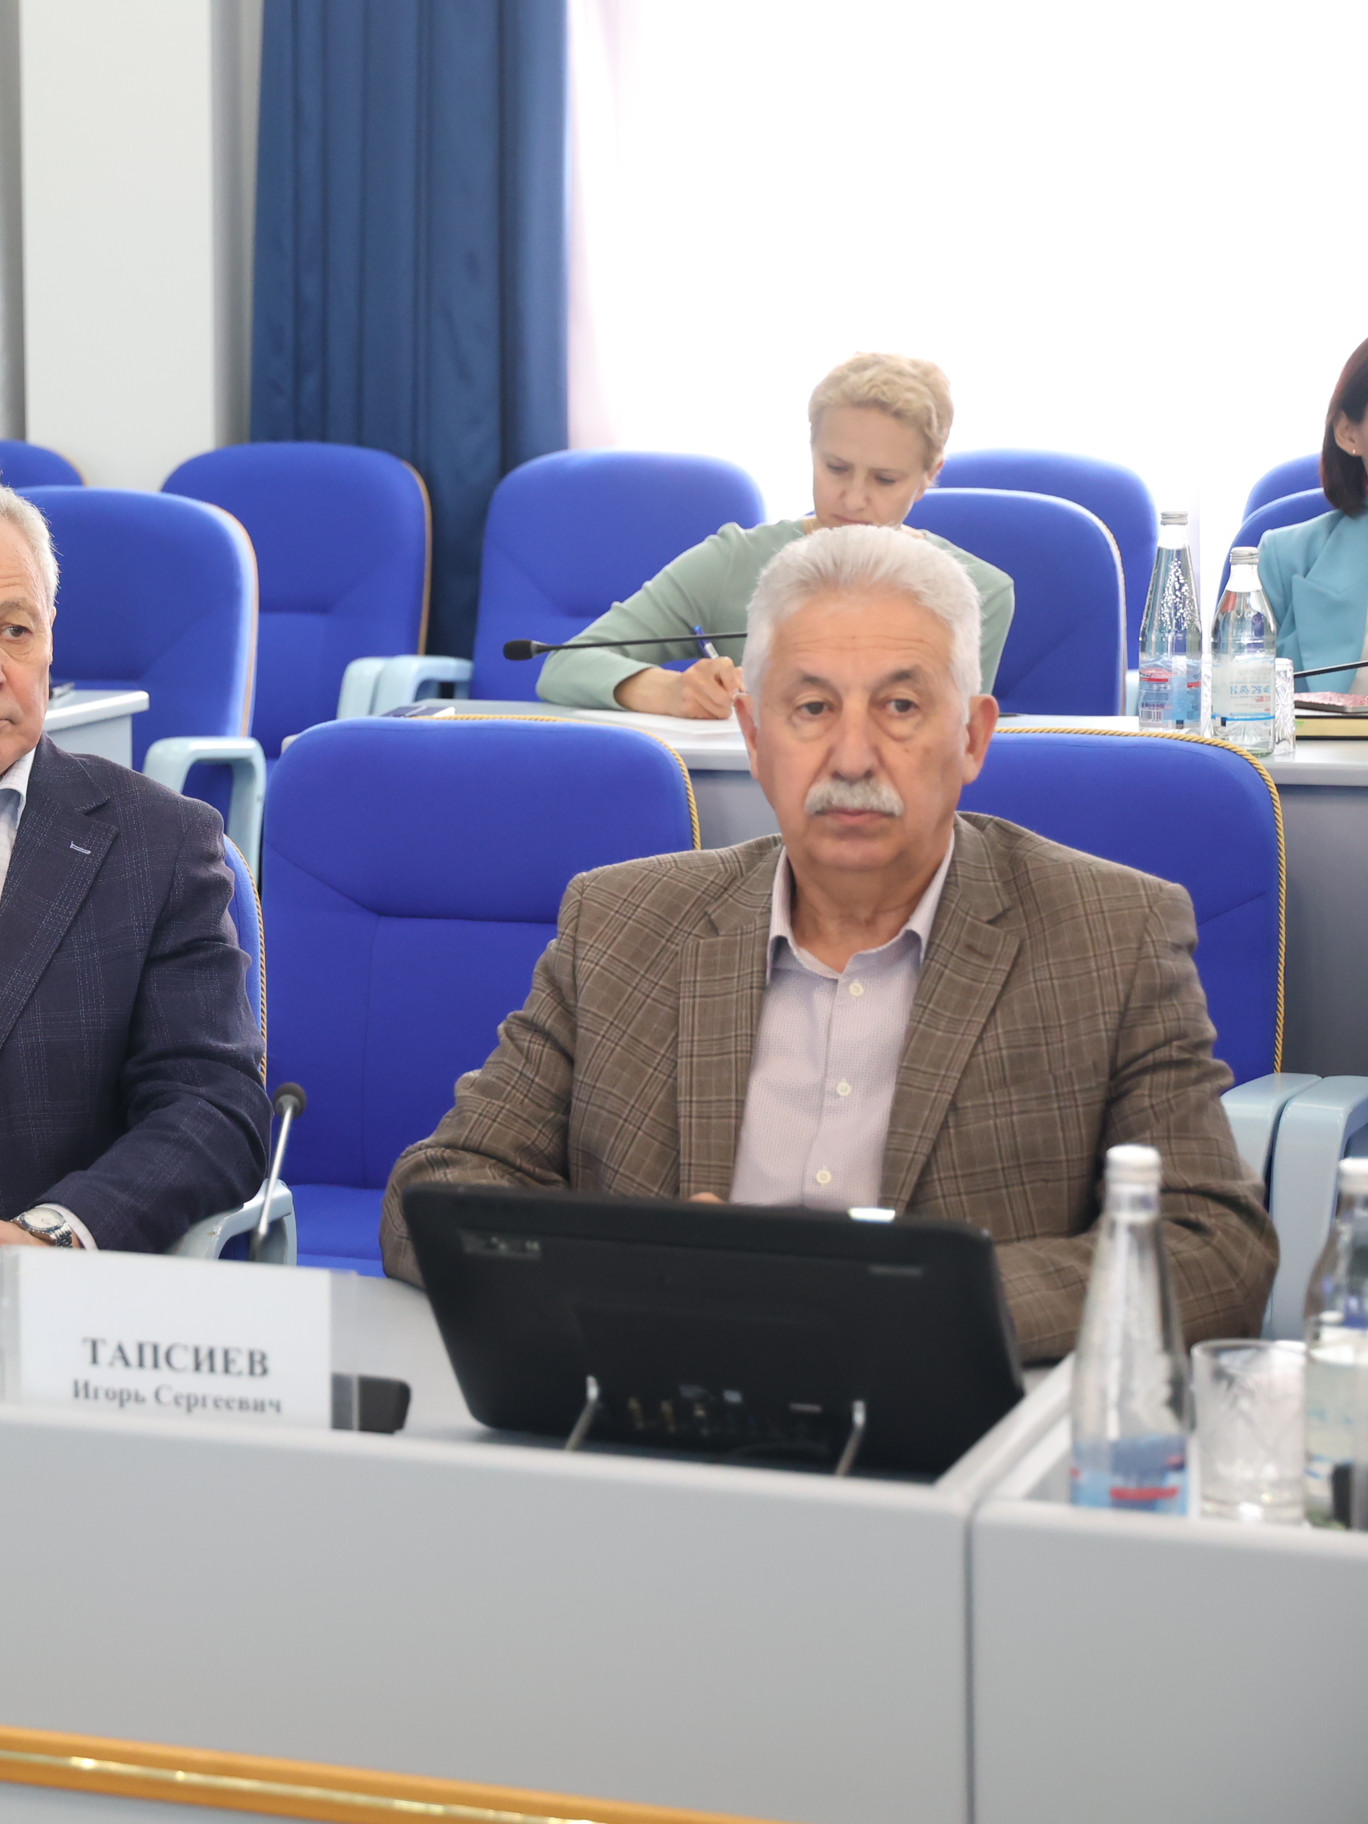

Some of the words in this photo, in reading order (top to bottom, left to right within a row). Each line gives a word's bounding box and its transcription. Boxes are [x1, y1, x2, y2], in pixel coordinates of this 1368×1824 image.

[82, 1337, 269, 1377] ТАПСИЕВ
[73, 1379, 146, 1409] Игорь
[154, 1384, 283, 1414] Сергеевич
